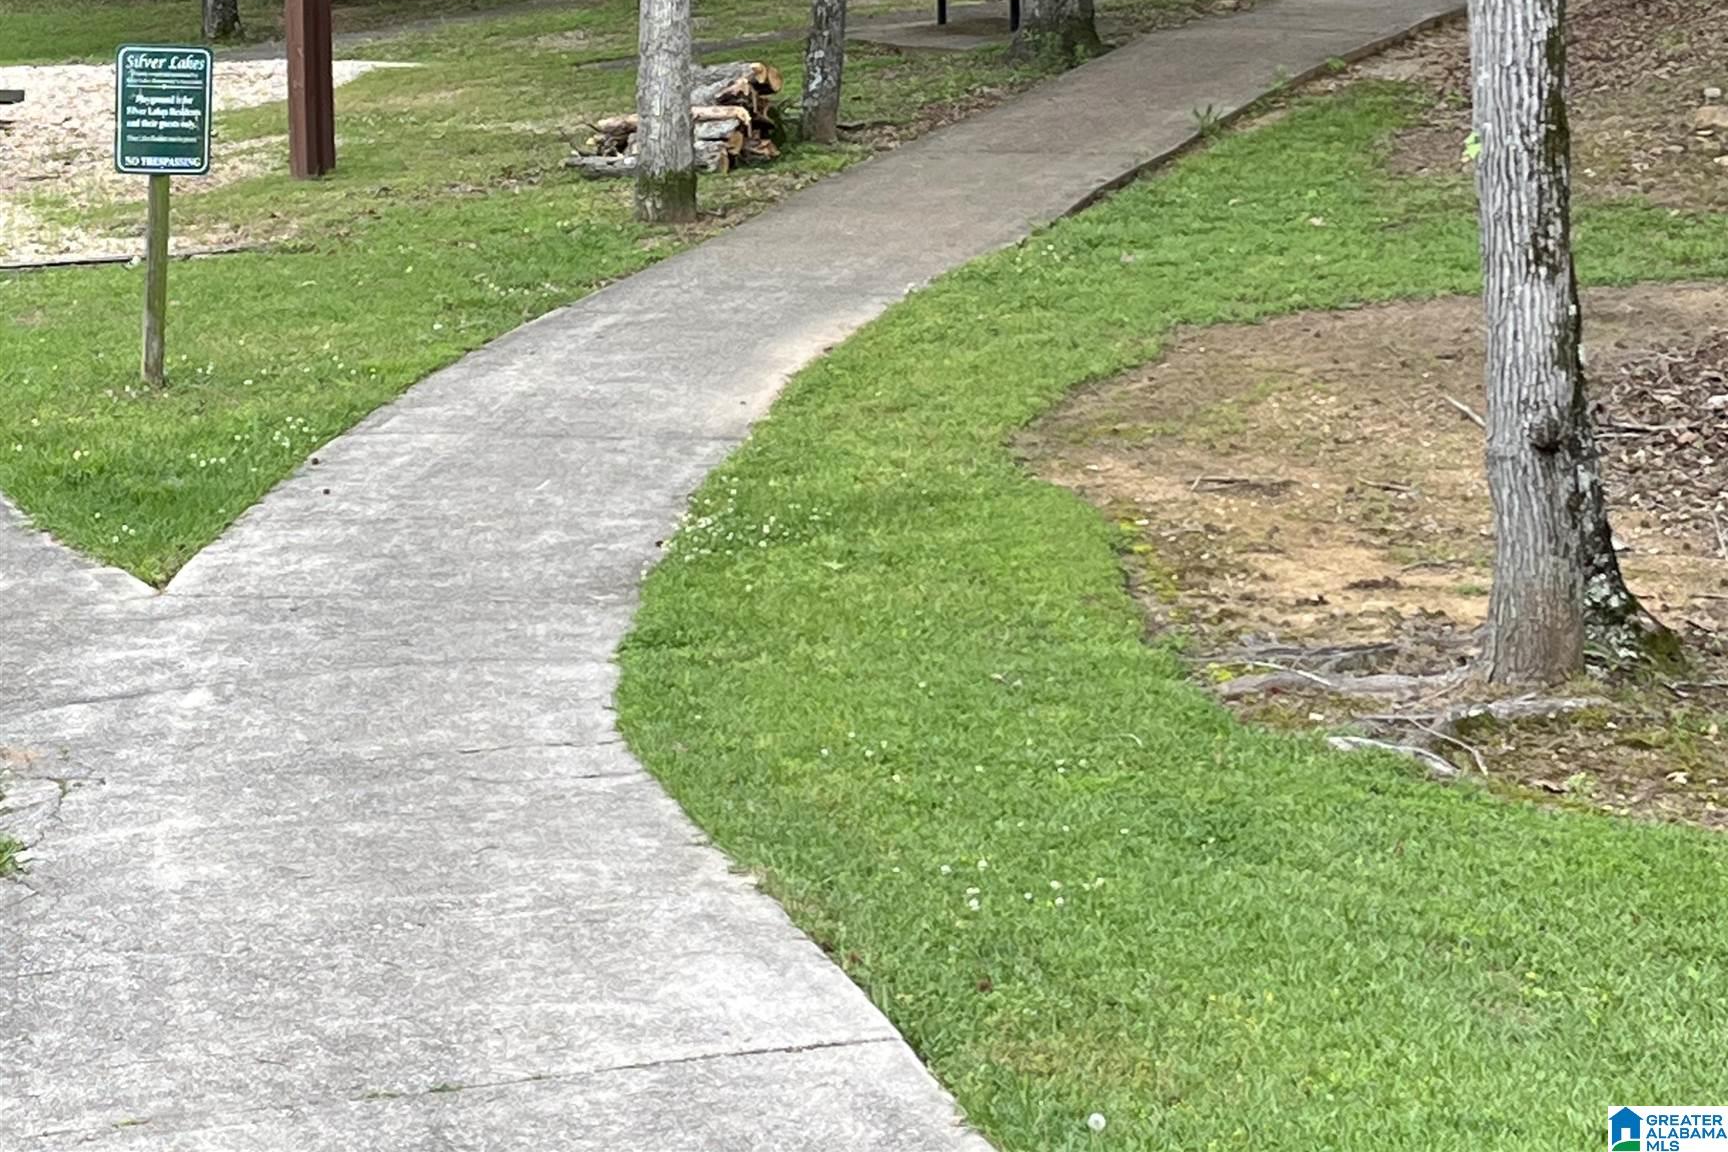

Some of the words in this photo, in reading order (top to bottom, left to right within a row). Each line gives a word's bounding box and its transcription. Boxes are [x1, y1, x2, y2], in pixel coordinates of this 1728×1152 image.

[126, 53, 167, 70] Silver
[168, 55, 205, 70] Lakes
[135, 94, 175, 106] Playground
[126, 106, 147, 115] Silver
[148, 107, 168, 116] Lakes
[126, 119, 140, 127] and
[141, 119, 158, 127] their
[159, 120, 179, 130] guests
[125, 156, 139, 166] NO
[140, 156, 201, 167] TRESPASSING
